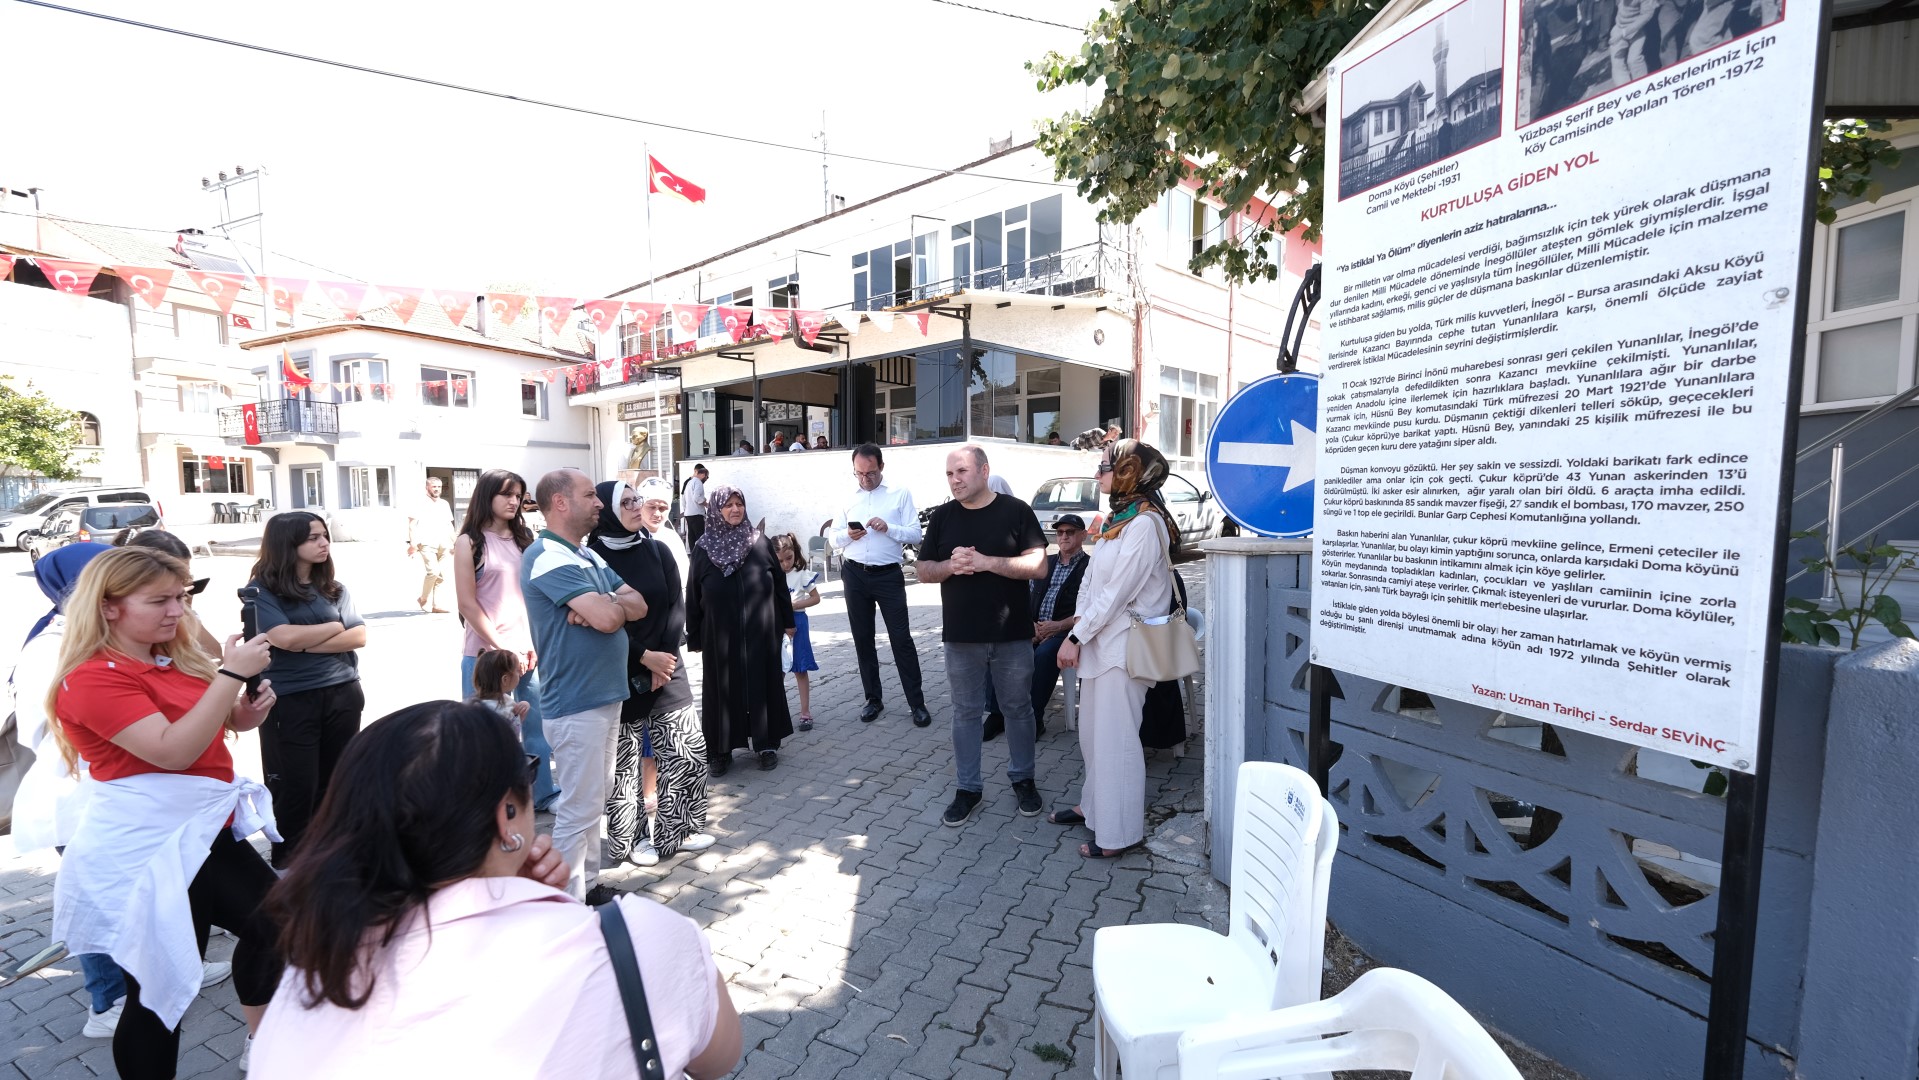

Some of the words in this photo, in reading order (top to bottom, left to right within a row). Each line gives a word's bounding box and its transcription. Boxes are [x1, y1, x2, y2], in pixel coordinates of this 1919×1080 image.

[1519, 120, 1562, 144] Yüzbaşı
[1565, 105, 1594, 128] Şerif
[1596, 96, 1622, 114] Bey
[1625, 89, 1642, 102] ve
[1644, 49, 1741, 95] Askerlerimiz
[1746, 35, 1776, 55] İçin
[1524, 141, 1547, 157] Köy
[1549, 116, 1614, 147] Camisinde
[1617, 95, 1668, 120] Yapılan
[1672, 77, 1716, 100] Tören
[1720, 56, 1764, 80] -1972
[1368, 188, 1393, 203] Doma
[1394, 177, 1416, 193] Köyü
[1417, 160, 1459, 185] (Şehitler)
[1390, 197, 1400, 206] ve
[1401, 181, 1436, 202] Mektebi
[1438, 172, 1461, 188] -1931
[1421, 183, 1504, 222] KURTULUŞA
[1507, 163, 1559, 192] GİDEN
[1563, 151, 1600, 172] YOL
[1505, 224, 1565, 249] bağımsızlık
[1567, 218, 1588, 232] için
[1590, 211, 1610, 225] tek
[1613, 200, 1649, 221] yürek
[1653, 187, 1696, 207] olarak
[1700, 167, 1771, 194] düşmana
[1541, 235, 1583, 253] ateşten
[1587, 219, 1634, 242] gömlek
[1639, 196, 1725, 229] giymişlerdir.
[1732, 181, 1770, 203] İşgal
[1350, 255, 1375, 270] istiklal
[1376, 252, 1387, 262] Ya
[1416, 229, 1462, 250] diyenlerin
[1463, 222, 1484, 235] aziz
[1515, 251, 1574, 273] İnegöllüler,
[1577, 242, 1600, 257] Milli
[1603, 227, 1666, 251] Mücadele
[1669, 220, 1694, 235] için
[1697, 202, 1769, 227] malzeme
[1515, 267, 1564, 286] baskınlar
[1565, 246, 1650, 274] düzenlemiştir.
[1531, 292, 1565, 309] İnegöl
[1576, 285, 1611, 300] Bursa
[1613, 268, 1680, 292] arasındaki
[1683, 262, 1720, 278] Aksu
[1724, 250, 1764, 269] Köyü
[1502, 310, 1559, 327] Yunanlılara
[1566, 303, 1596, 316] karşı,
[1604, 290, 1648, 308] önemli
[1657, 280, 1706, 298] ölçüde
[1716, 268, 1764, 287] zayiat
[1507, 353, 1543, 366] sonrası
[1546, 347, 1568, 362] geri
[1571, 343, 1613, 358] çekilen
[1617, 332, 1684, 350] Yunanlılar,
[1546, 359, 1597, 374] mevkiine
[1606, 348, 1670, 368] çekilmişti.
[1682, 338, 1757, 356] Yunanlılar,
[1508, 390, 1559, 405] müfrezesi
[1564, 388, 1580, 399] 20
[1586, 385, 1614, 397] Mart
[1674, 371, 1755, 388] Yunanlılara
[1529, 375, 1570, 389] başladı.
[1576, 368, 1643, 384] Yunanlılara
[1649, 363, 1677, 376] ağır
[1683, 359, 1704, 372] bir
[1710, 354, 1757, 368] darbe
[1519, 416, 1570, 432] yanındaki
[1574, 415, 1590, 426] 25
[1594, 412, 1629, 426] kişilik
[1634, 406, 1701, 422] müfrezesi
[1707, 405, 1725, 416] ile
[1732, 403, 1753, 415] bu
[1529, 402, 1577, 416] dikenleri
[1581, 398, 1615, 412] telleri
[1620, 395, 1663, 408] söküp,
[1668, 385, 1754, 406] geçecekleri
[1504, 462, 1516, 470] ve
[1519, 458, 1562, 469] sessizdi.
[1566, 456, 1609, 468] Yoldaki
[1612, 455, 1661, 467] barikatı
[1666, 454, 1693, 465] fark
[1698, 453, 1749, 464] edince
[1565, 472, 1581, 482] 43
[1588, 471, 1626, 481] Yunan
[1633, 469, 1708, 481] askerinden
[1509, 499, 1522, 508] 27
[1524, 499, 1559, 509] sandık
[1560, 499, 1571, 509] el
[1573, 499, 1628, 512] bombası,
[1631, 500, 1654, 511] 170
[1656, 502, 1710, 513] mavzer,
[1714, 501, 1745, 512] 250
[1518, 486, 1541, 496] olan
[1545, 485, 1563, 496] biri
[1567, 485, 1596, 496] öldü.
[1601, 485, 1610, 496] 6
[1614, 486, 1654, 498] araçta
[1659, 485, 1694, 496] imha
[1700, 484, 1746, 496] edildi.
[1509, 512, 1587, 525] Komutanlığına
[1589, 514, 1641, 526] yollandı.
[1511, 539, 1558, 550] mevkiine
[1560, 541, 1605, 554] gelince,
[1608, 543, 1654, 555] Ermeni
[1657, 547, 1718, 559] çeteciler
[1722, 549, 1741, 561] ile
[1540, 553, 1582, 565] onlarda
[1584, 555, 1639, 569] karşıdaki
[1641, 560, 1682, 572] Doma
[1685, 562, 1739, 577] köyünü
[1515, 564, 1534, 575] için
[1535, 565, 1561, 578] köye
[1563, 569, 1606, 581] gelirler.
[1508, 589, 1562, 604] isteyenleri
[1563, 595, 1578, 606] de
[1580, 599, 1629, 612] vururlar.
[1632, 603, 1672, 617] Doma
[1675, 607, 1735, 627] köylüler,
[1533, 580, 1546, 589] ve
[1551, 582, 1593, 594] yaşlıları
[1599, 587, 1652, 600] camiinin
[1659, 590, 1692, 604] içine
[1699, 597, 1737, 609] zorla
[1501, 626, 1518, 637] her
[1519, 631, 1555, 643] zaman
[1557, 634, 1618, 654] hatırlamak
[1621, 647, 1636, 657] ve
[1639, 647, 1680, 664] köyün
[1683, 656, 1732, 674] vermiş
[1526, 645, 1543, 655] adı
[1549, 647, 1574, 660] 1972
[1580, 654, 1620, 668] yılında
[1627, 660, 1678, 678] Şehitler
[1685, 671, 1731, 688] olarak
[1471, 683, 1506, 701] Yazan:
[1509, 692, 1550, 711] Uzman
[1553, 702, 1595, 722] Tarihçi
[1609, 715, 1658, 736] Serdar
[1661, 727, 1726, 754] SEVİNÇ
